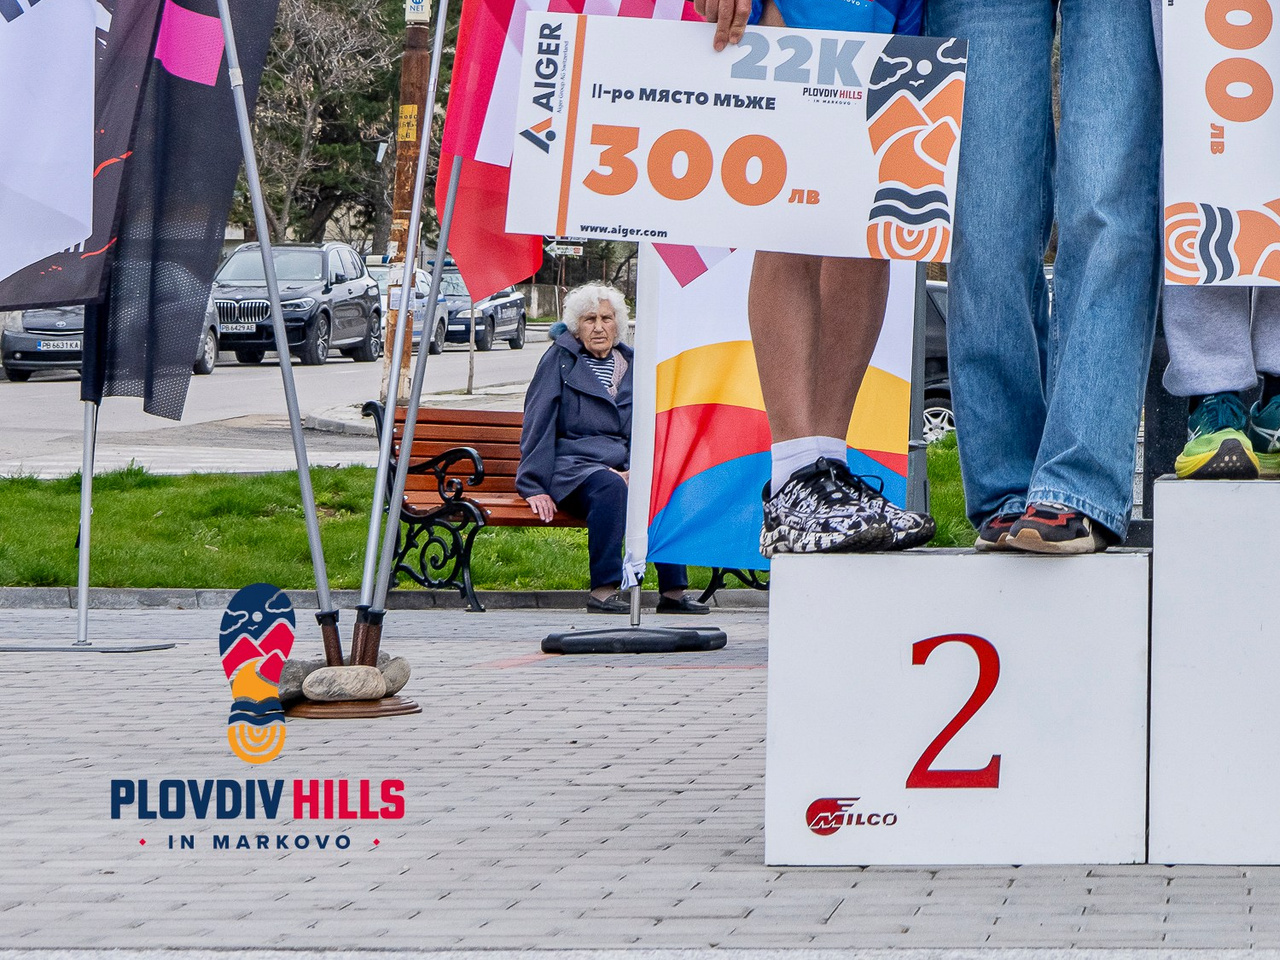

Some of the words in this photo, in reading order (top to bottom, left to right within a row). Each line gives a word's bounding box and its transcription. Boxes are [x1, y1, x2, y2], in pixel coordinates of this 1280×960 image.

[532, 23, 563, 113] AIGER
[730, 31, 866, 87] 22K
[639, 88, 709, 107] МЯСТО
[713, 92, 776, 110] МЪЖЕ
[803, 86, 838, 99] PLOVDIV
[839, 90, 863, 100] HILLS
[582, 124, 787, 206] 300
[580, 223, 668, 238] www.aiger.com
[905, 634, 1001, 790] 2
[809, 811, 898, 828] MILCO
